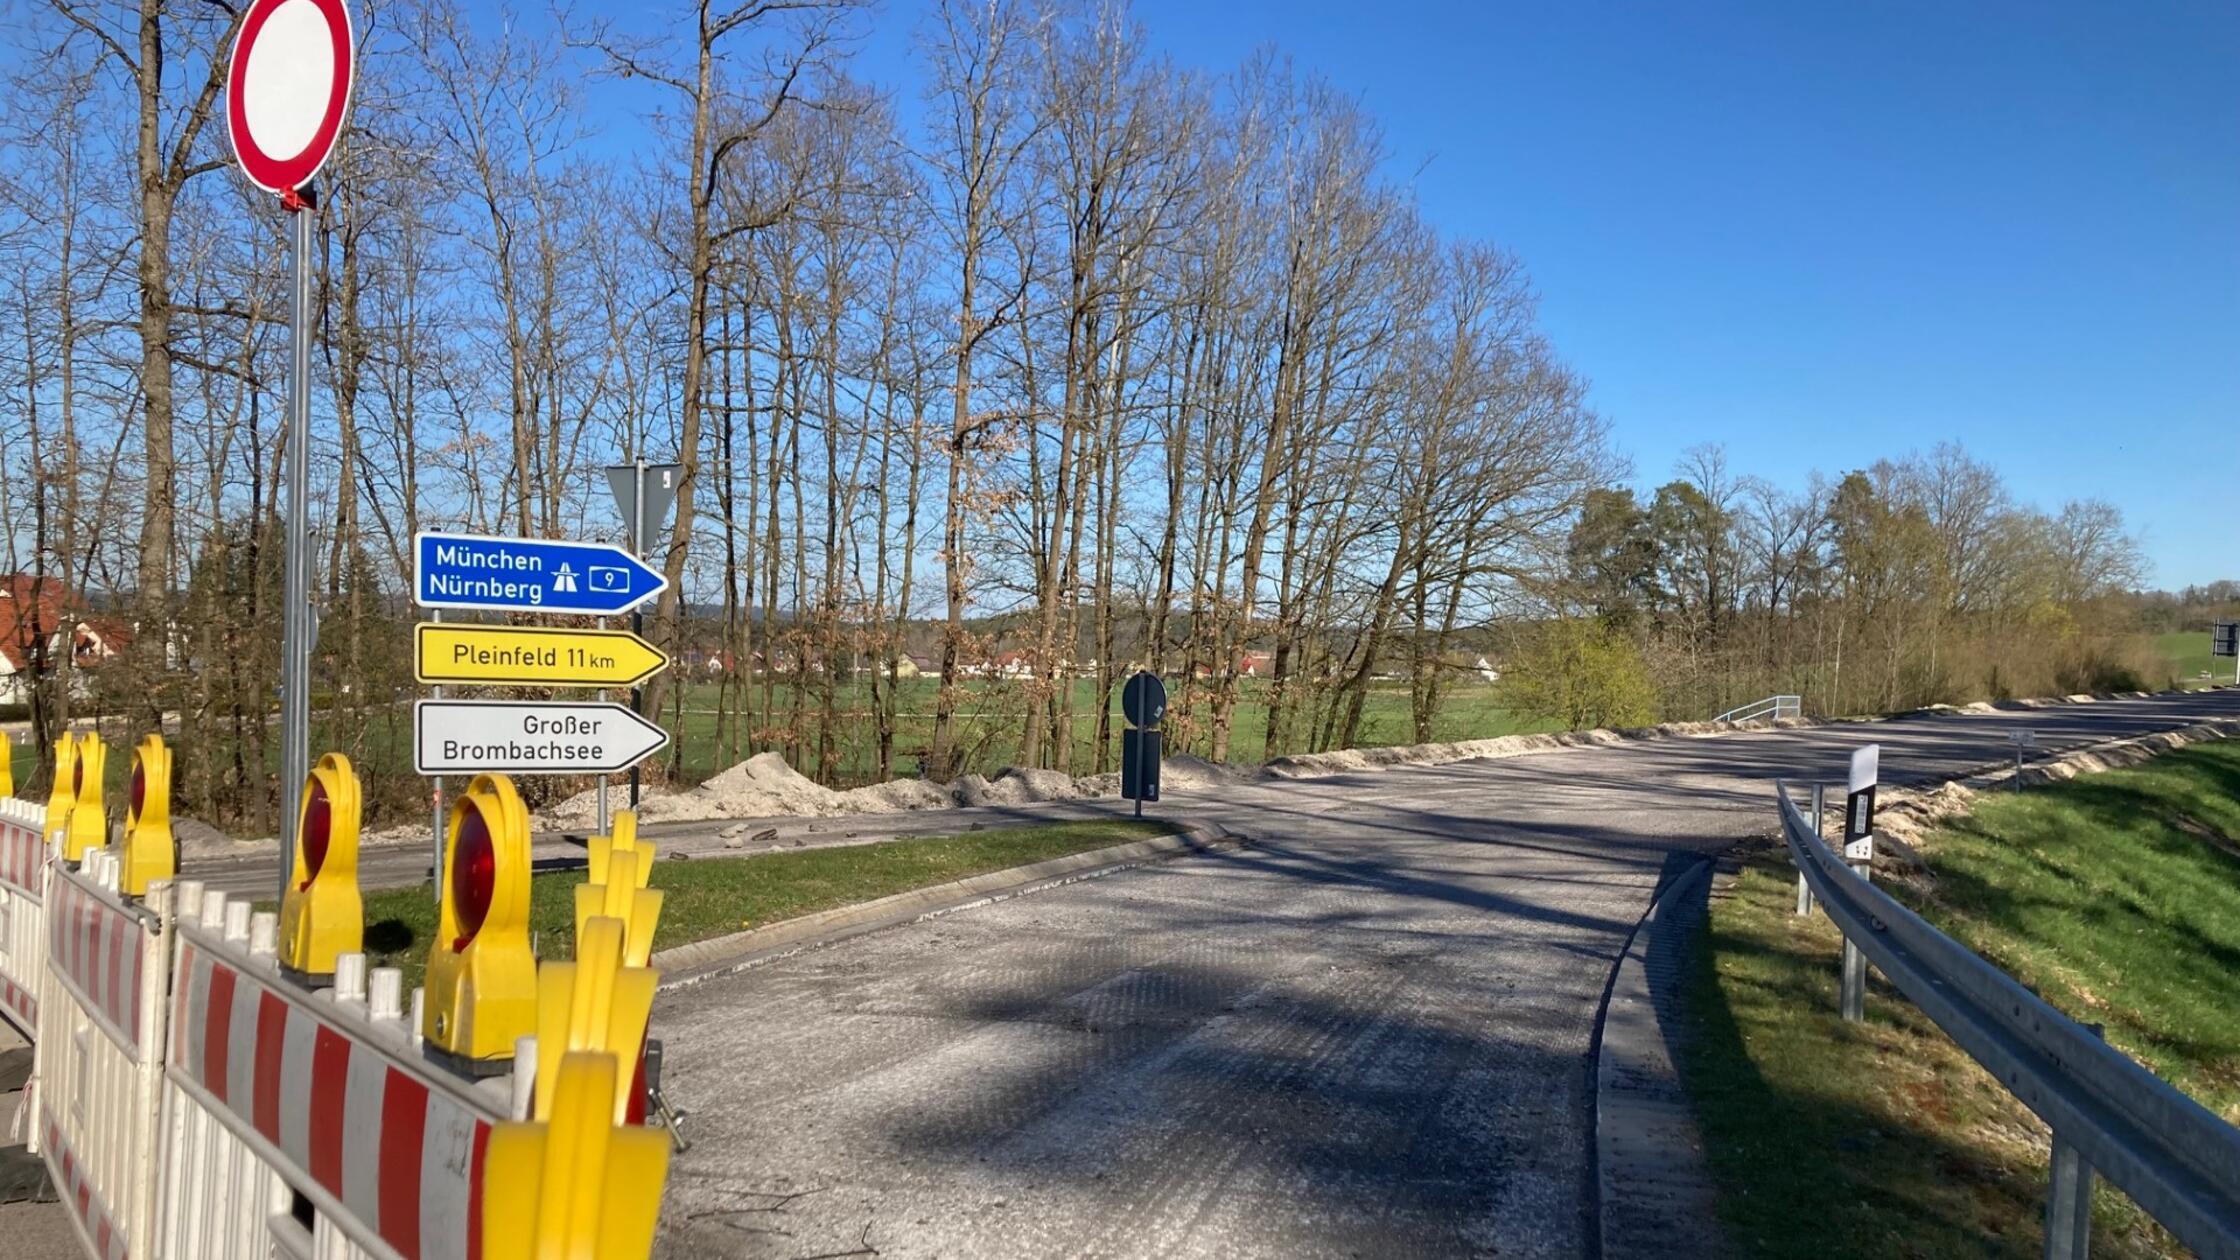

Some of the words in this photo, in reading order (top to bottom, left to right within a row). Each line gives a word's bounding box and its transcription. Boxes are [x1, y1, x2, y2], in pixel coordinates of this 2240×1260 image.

[437, 545, 542, 571] München
[430, 574, 542, 604] Nürnberg
[604, 572, 614, 587] 9
[453, 644, 556, 667] Pleinfeld
[567, 648, 585, 667] 11
[590, 654, 615, 668] km
[523, 715, 602, 735] Großer
[444, 740, 602, 760] Brombachsee
